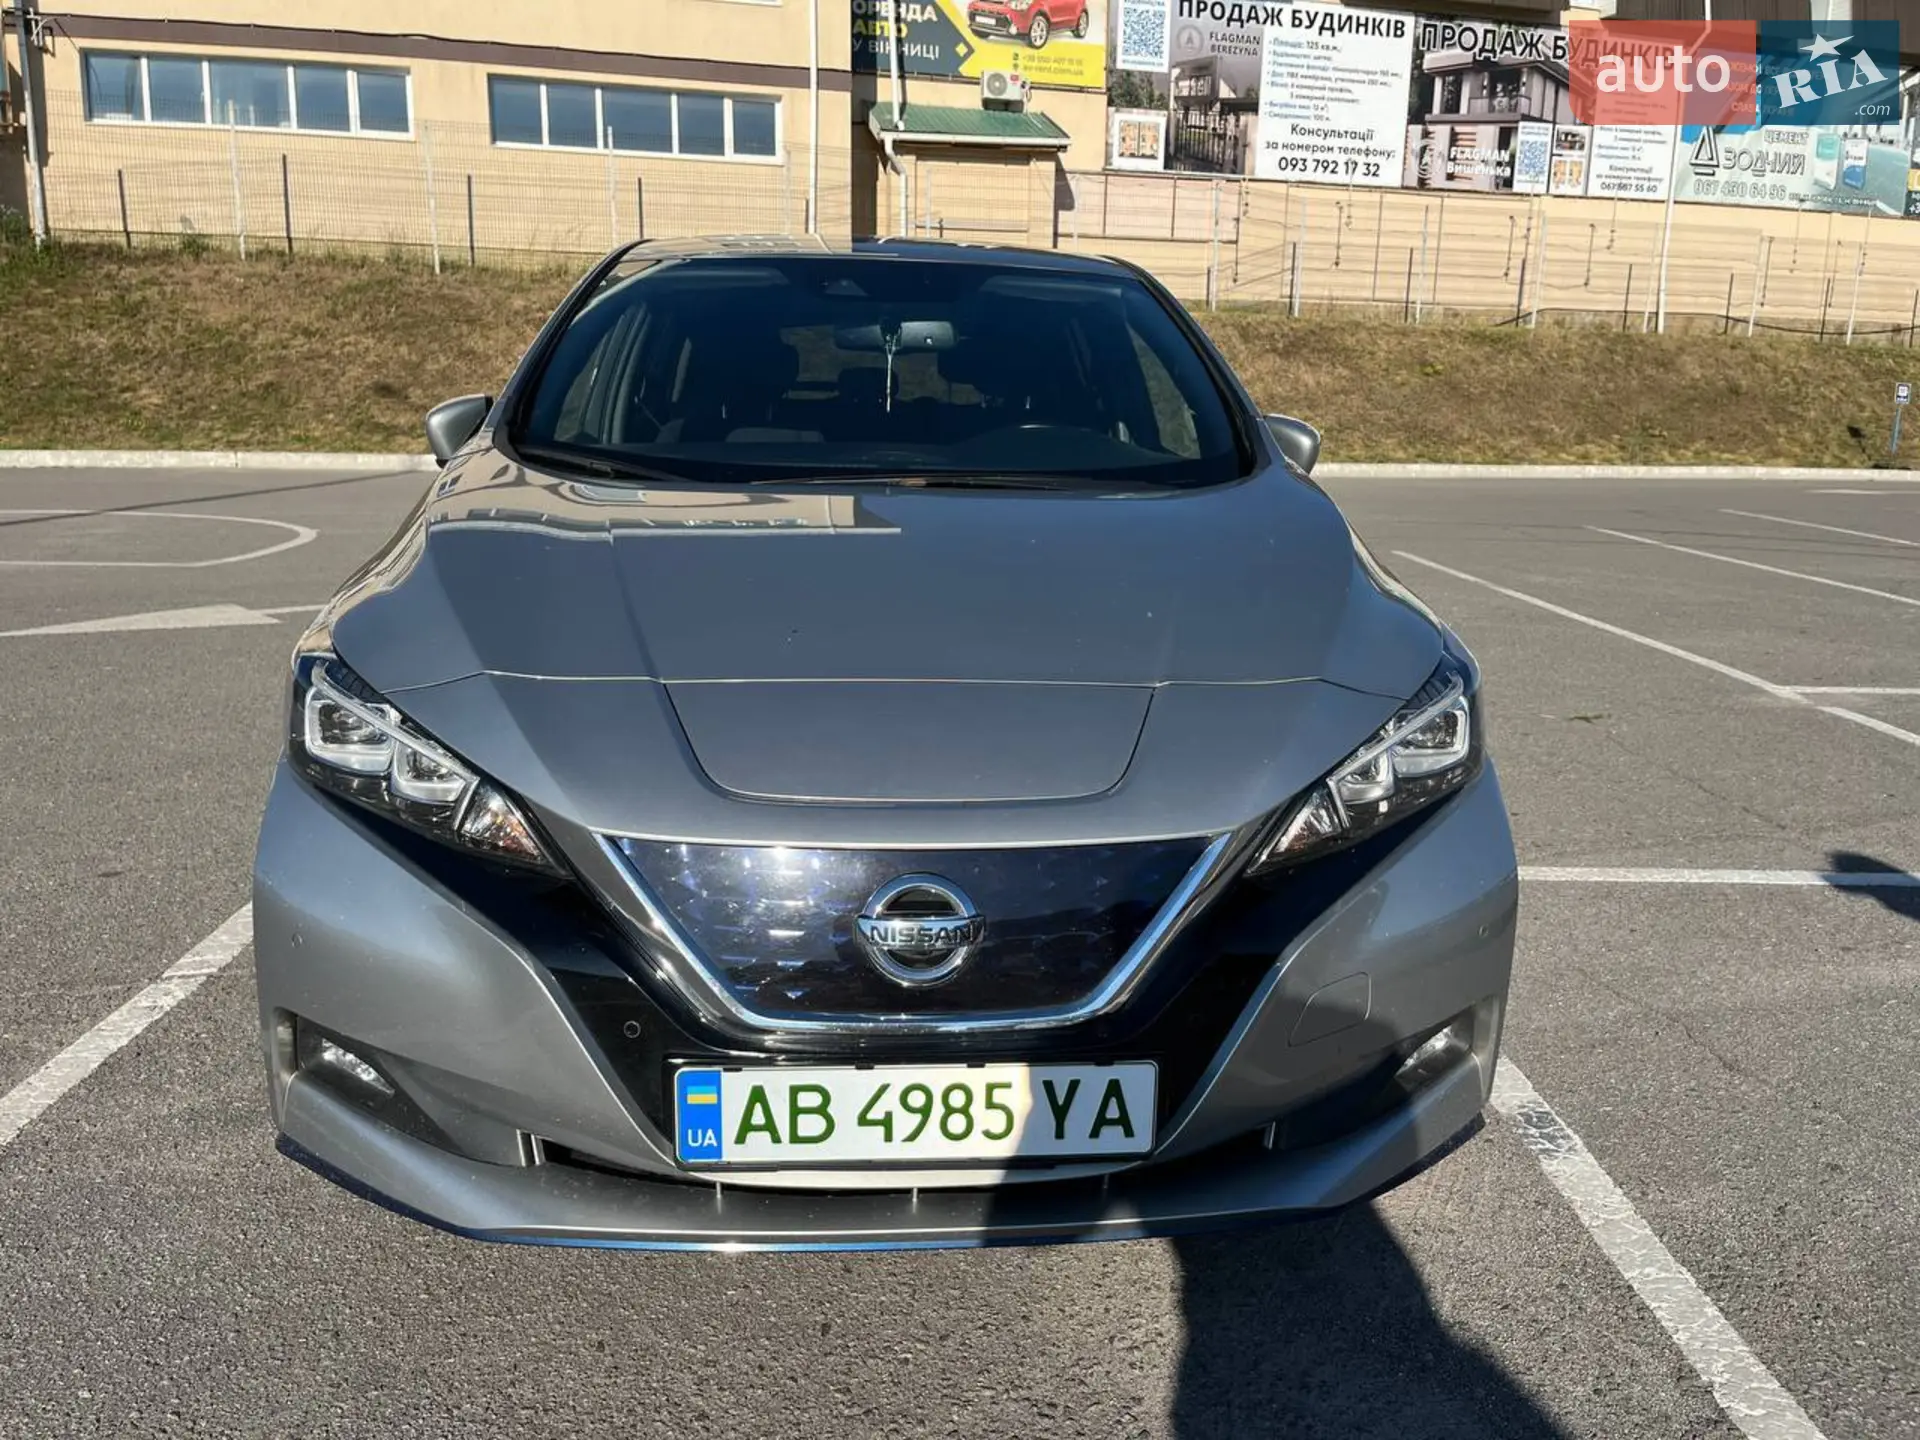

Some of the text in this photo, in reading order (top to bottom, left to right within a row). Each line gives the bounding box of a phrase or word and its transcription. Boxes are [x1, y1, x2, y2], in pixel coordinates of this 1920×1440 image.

[1179, 0, 1407, 39] ПРОДАЖ БУДИНКІВ
[1209, 31, 1260, 46] FLAGMAN
[1422, 23, 1543, 60] ПРОДАЖ
[1210, 45, 1259, 56] BEREZYNA
[1290, 123, 1375, 142] Консультації
[1265, 141, 1279, 150] за
[1281, 141, 1334, 155] номером
[1450, 147, 1510, 162] FLAGMAN
[1278, 156, 1308, 172] 093
[1312, 158, 1339, 175] 792
[1362, 162, 1380, 177] 32
[869, 924, 975, 945] NISSAN
[734, 1078, 1135, 1145] AB 4985 YA
[688, 1130, 718, 1147] UA
